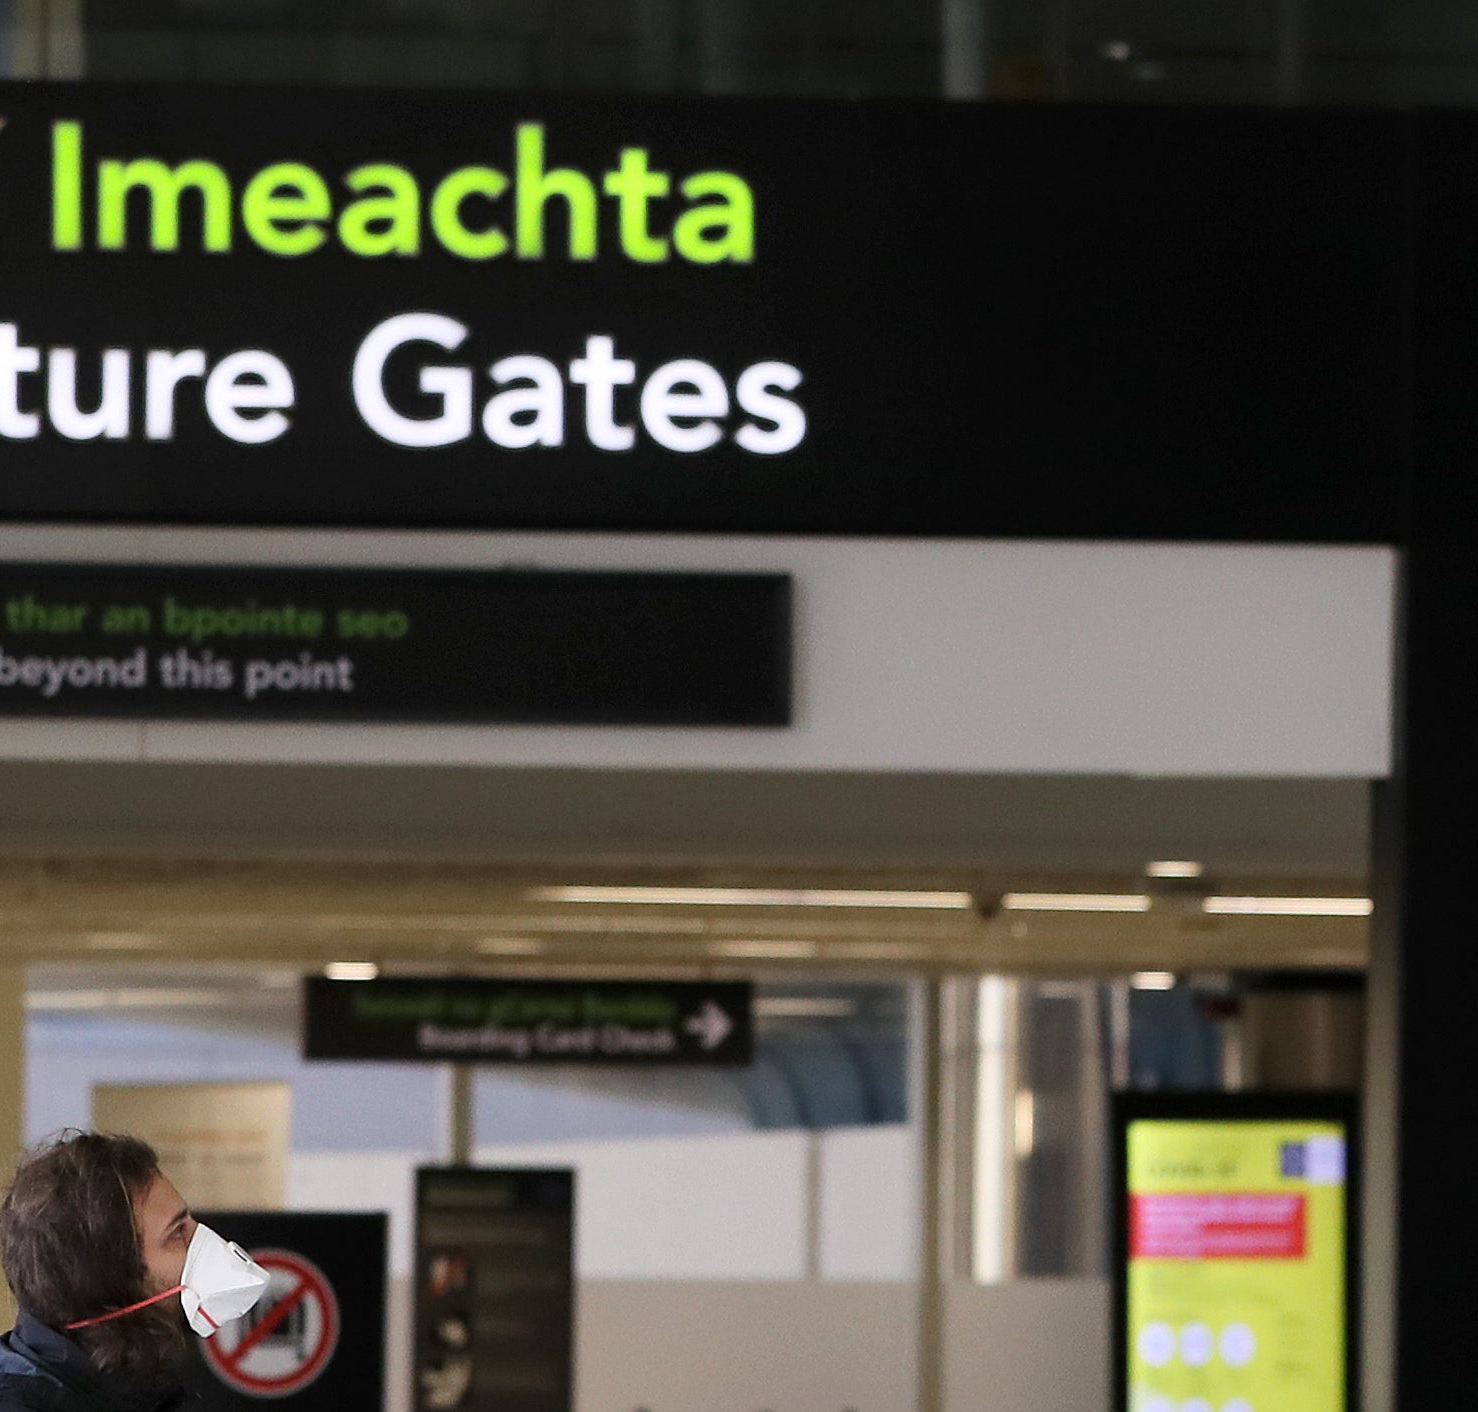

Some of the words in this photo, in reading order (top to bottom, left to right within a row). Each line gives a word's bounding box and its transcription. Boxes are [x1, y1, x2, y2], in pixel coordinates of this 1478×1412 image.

[51, 120, 756, 264] Imeachta
[351, 312, 808, 455] Gates
[4, 594, 88, 633] thar
[100, 605, 152, 634] an
[336, 609, 410, 640] seo
[159, 647, 234, 690] this
[244, 651, 353, 700] point
